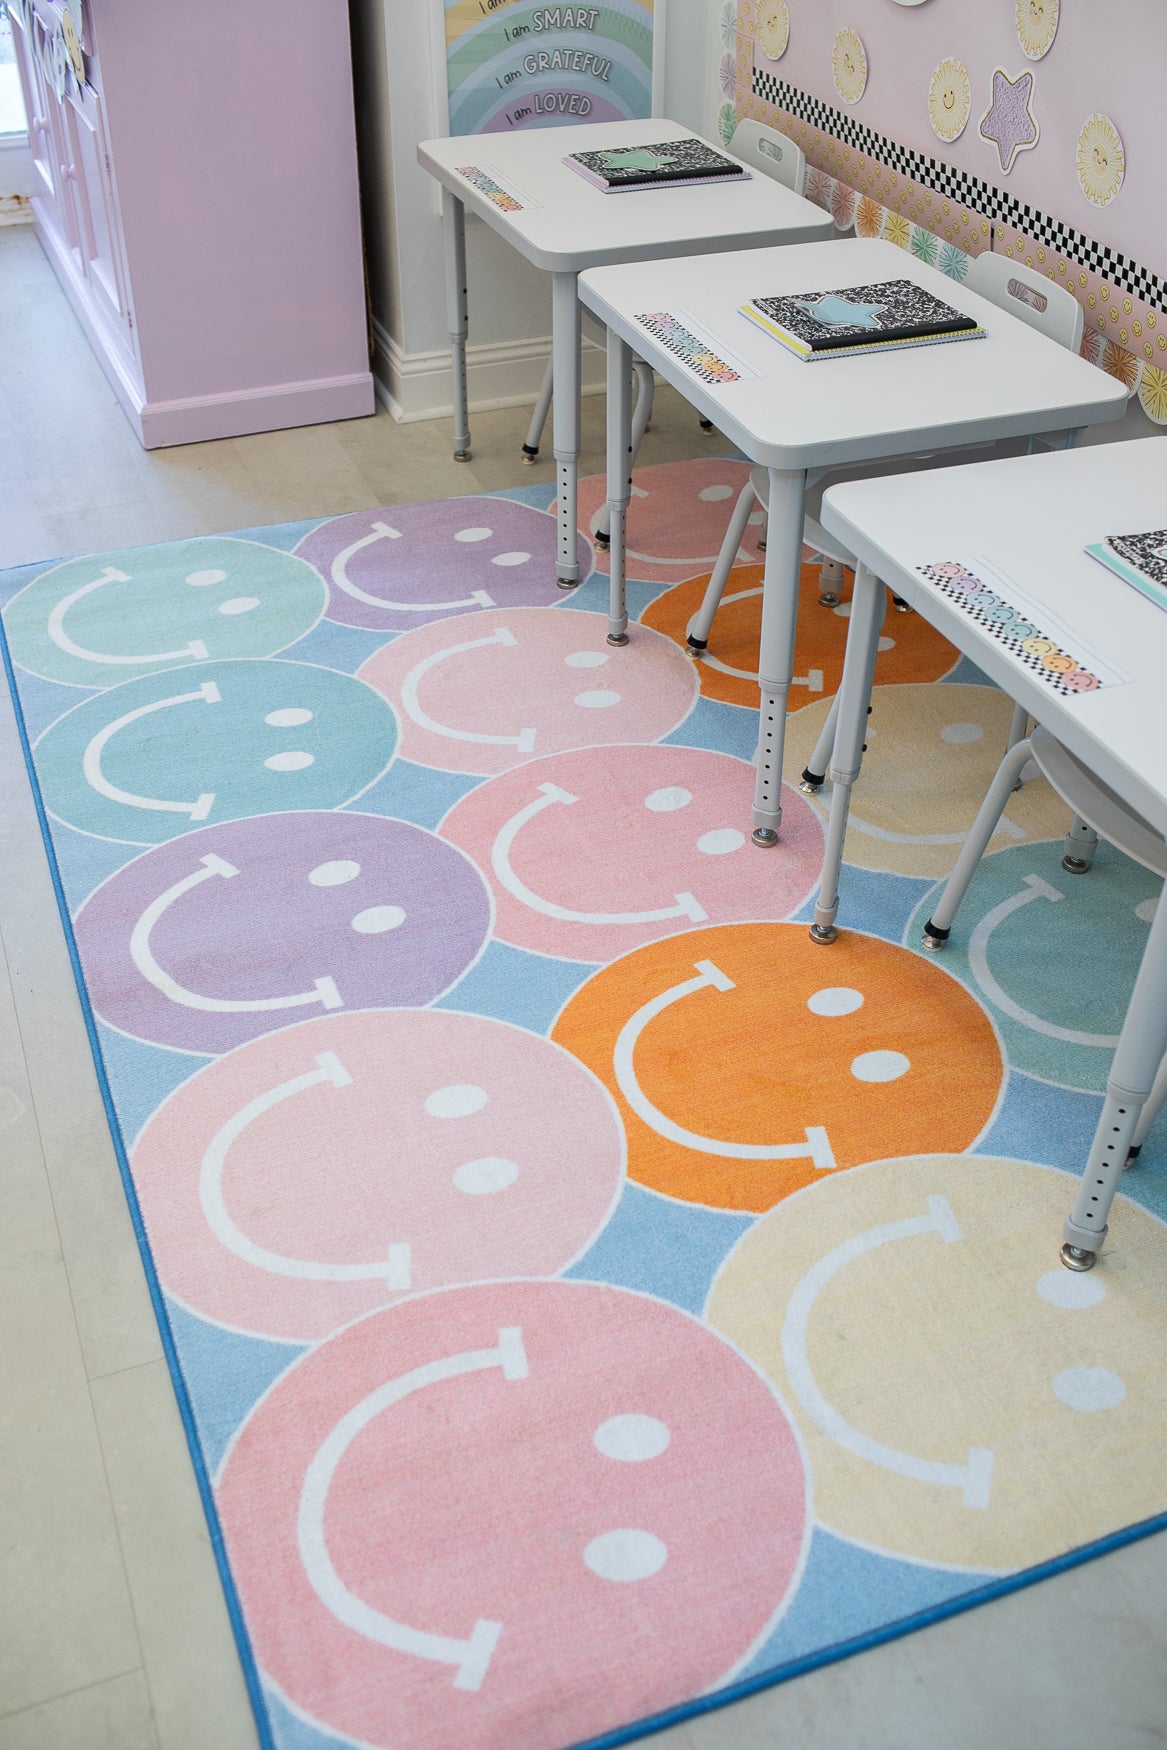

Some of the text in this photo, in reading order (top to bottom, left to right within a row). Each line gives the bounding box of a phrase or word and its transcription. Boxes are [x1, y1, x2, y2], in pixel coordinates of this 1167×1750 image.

[504, 8, 599, 41] I am SMART
[495, 49, 613, 89] I am GRATEFUL
[505, 93, 592, 125] I am LOVED
